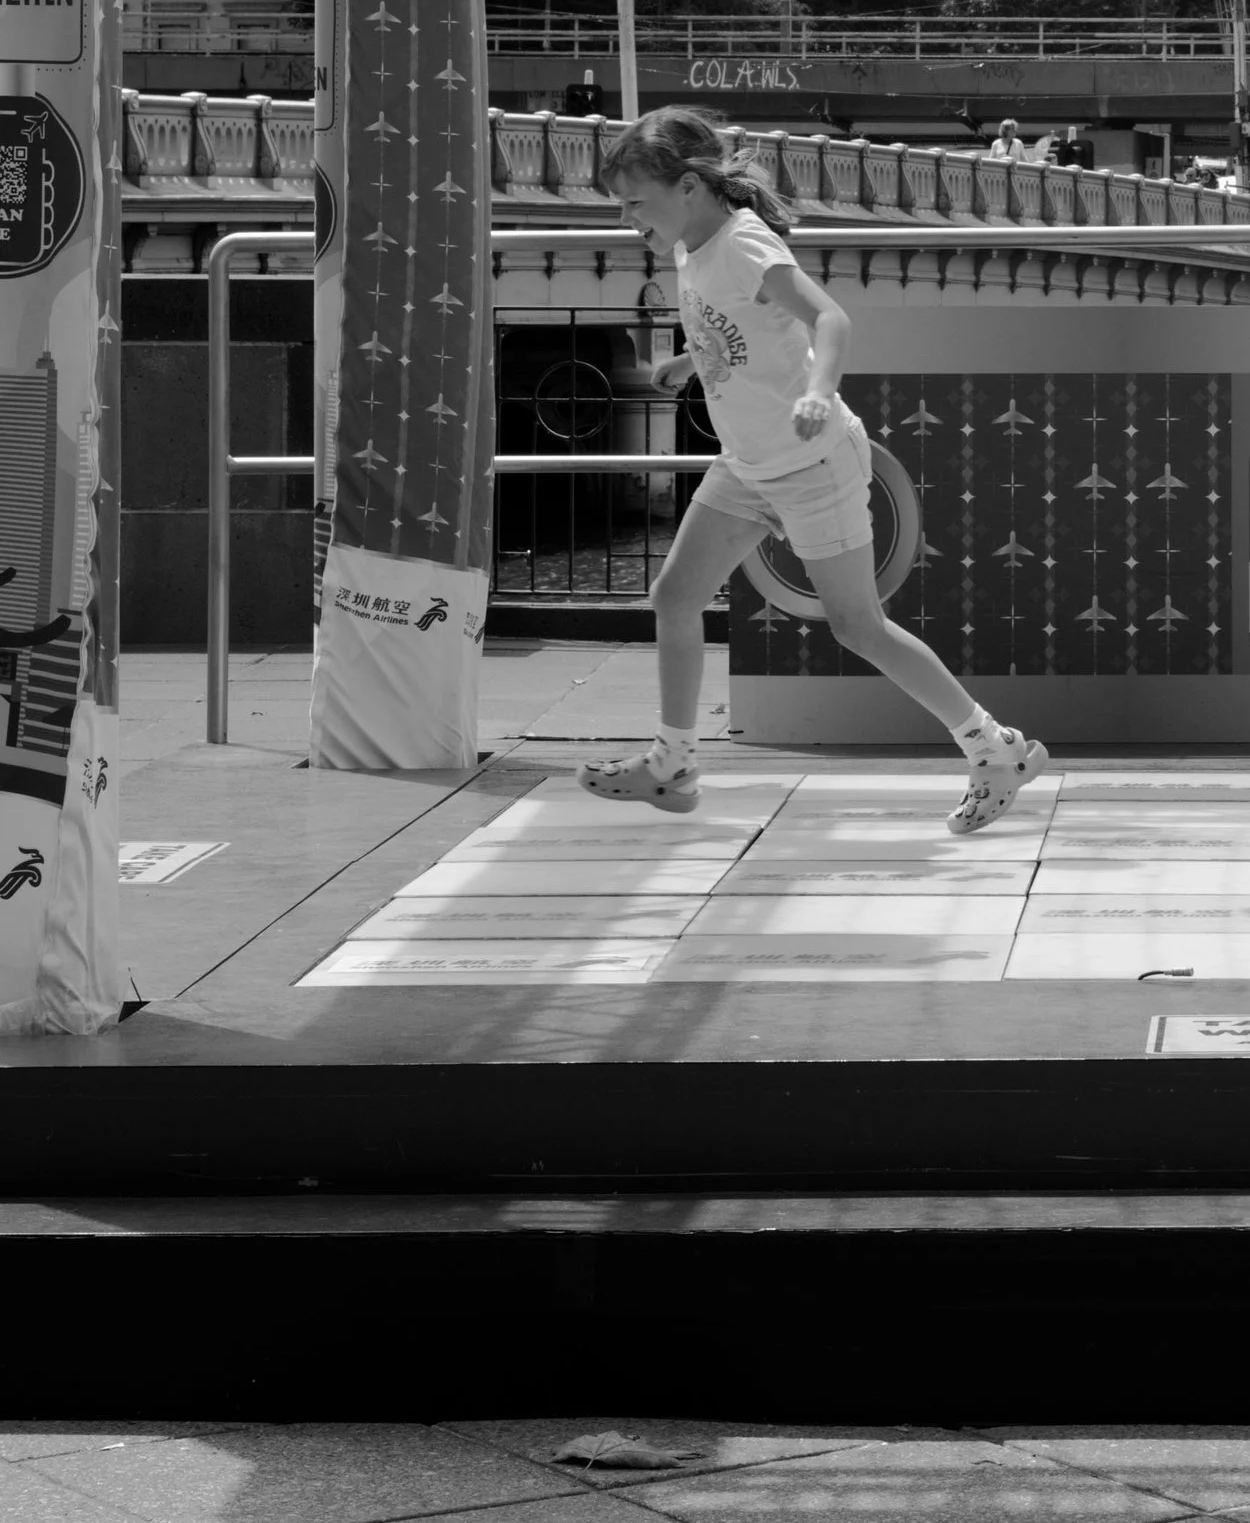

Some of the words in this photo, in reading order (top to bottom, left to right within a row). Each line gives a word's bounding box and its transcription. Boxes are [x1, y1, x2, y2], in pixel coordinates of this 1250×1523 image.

[336, 585, 411, 616] 深圳航空
[373, 614, 409, 626] Airlines
